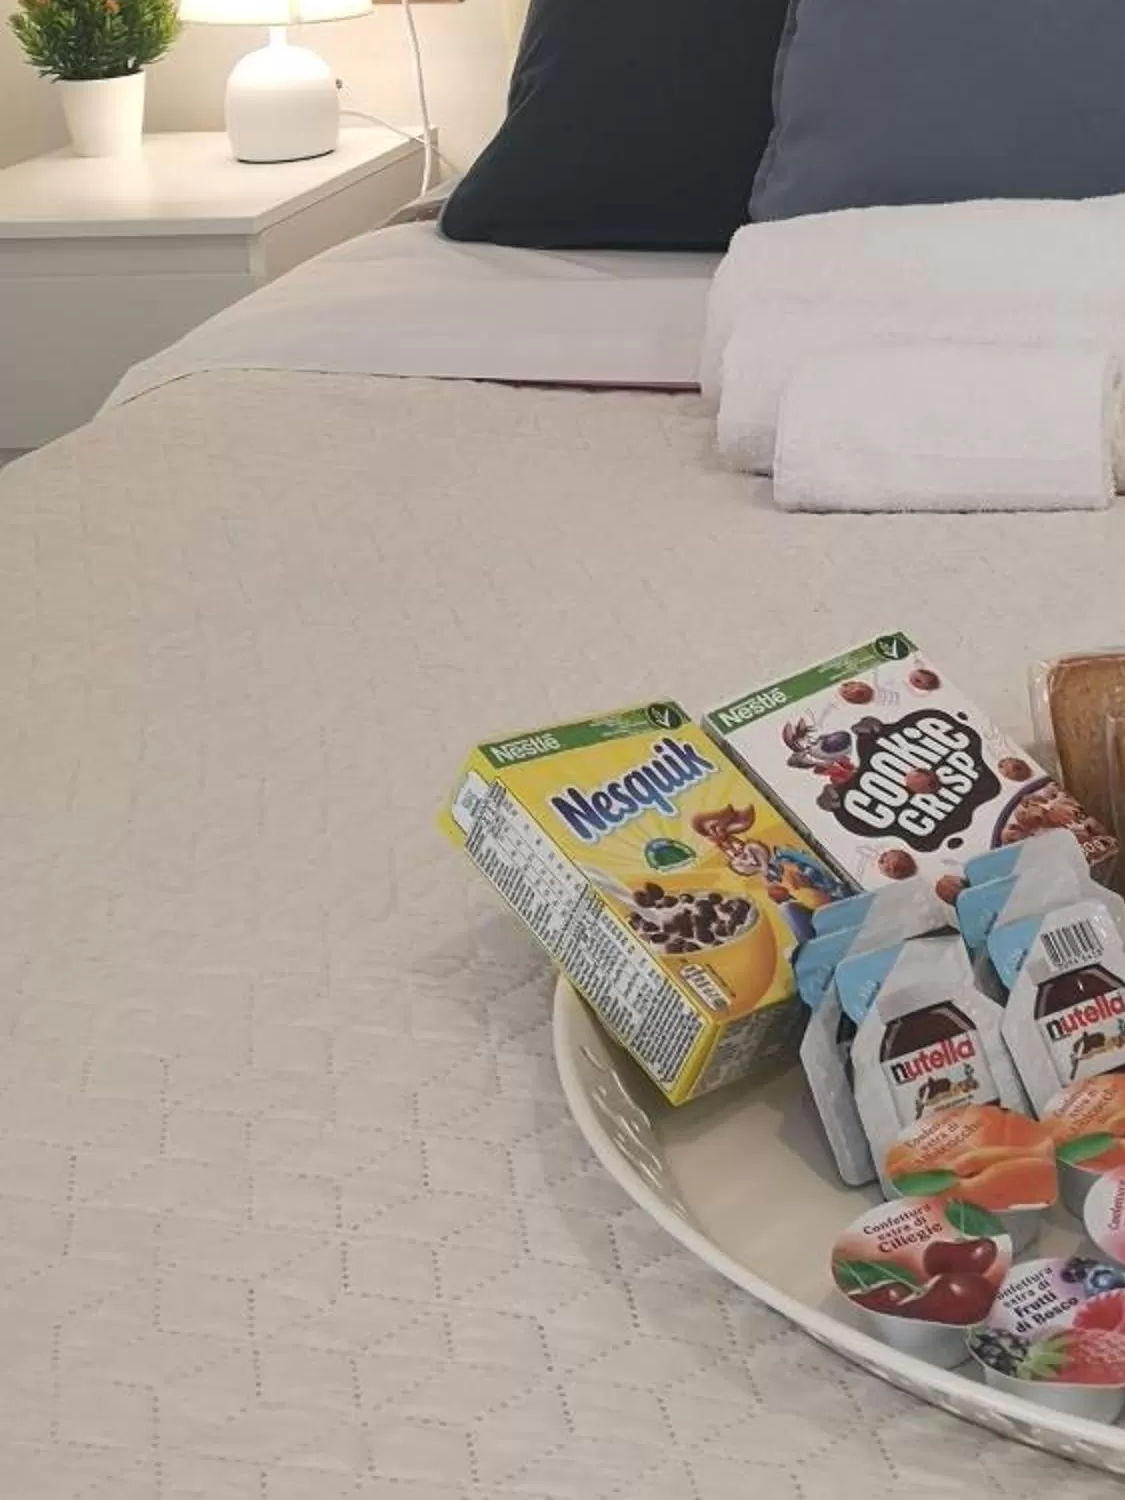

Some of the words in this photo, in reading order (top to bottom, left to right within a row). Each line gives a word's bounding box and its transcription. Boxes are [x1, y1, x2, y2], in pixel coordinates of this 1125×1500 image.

[550, 736, 716, 840] Nesquik
[891, 1037, 976, 1085] nutella
[863, 1203, 932, 1235] Confettura
[878, 1222, 943, 1253] Ciliegie
[1013, 1290, 1057, 1318] Frutti
[1015, 1319, 1033, 1333] di
[1031, 1297, 1078, 1325] Bosco
